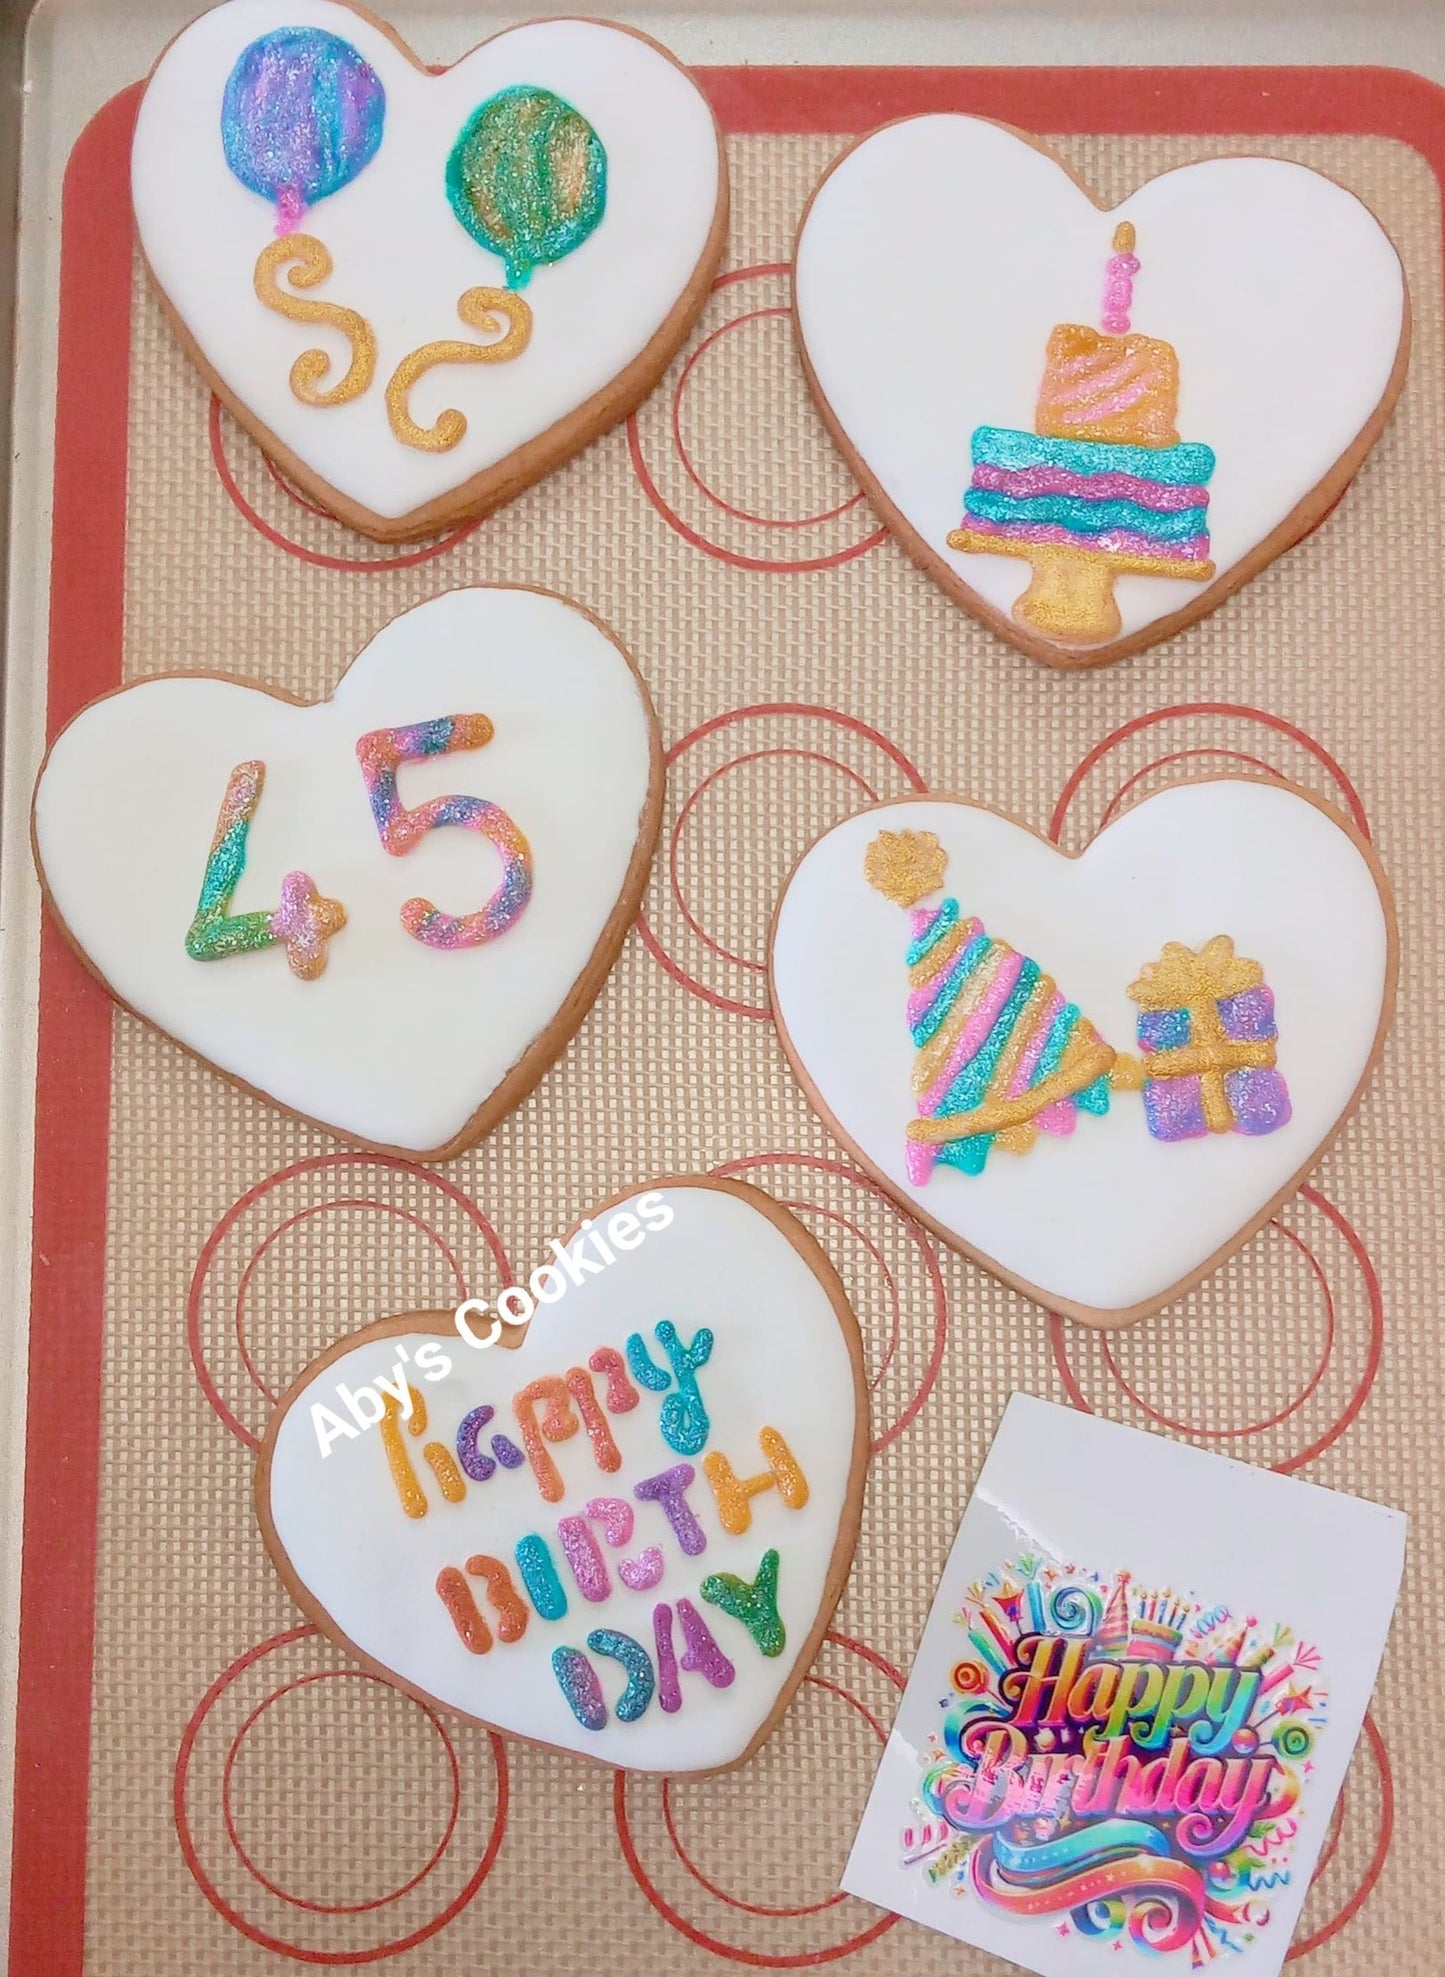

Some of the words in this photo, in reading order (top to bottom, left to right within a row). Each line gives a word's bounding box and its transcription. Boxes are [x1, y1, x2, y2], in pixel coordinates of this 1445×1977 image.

[185, 712, 534, 982] 45
[435, 1426, 810, 1655] BIRTH
[551, 1548, 787, 1731] DAY
[998, 1632, 1262, 1757] Happy
[942, 1718, 1278, 1862] Birthday
